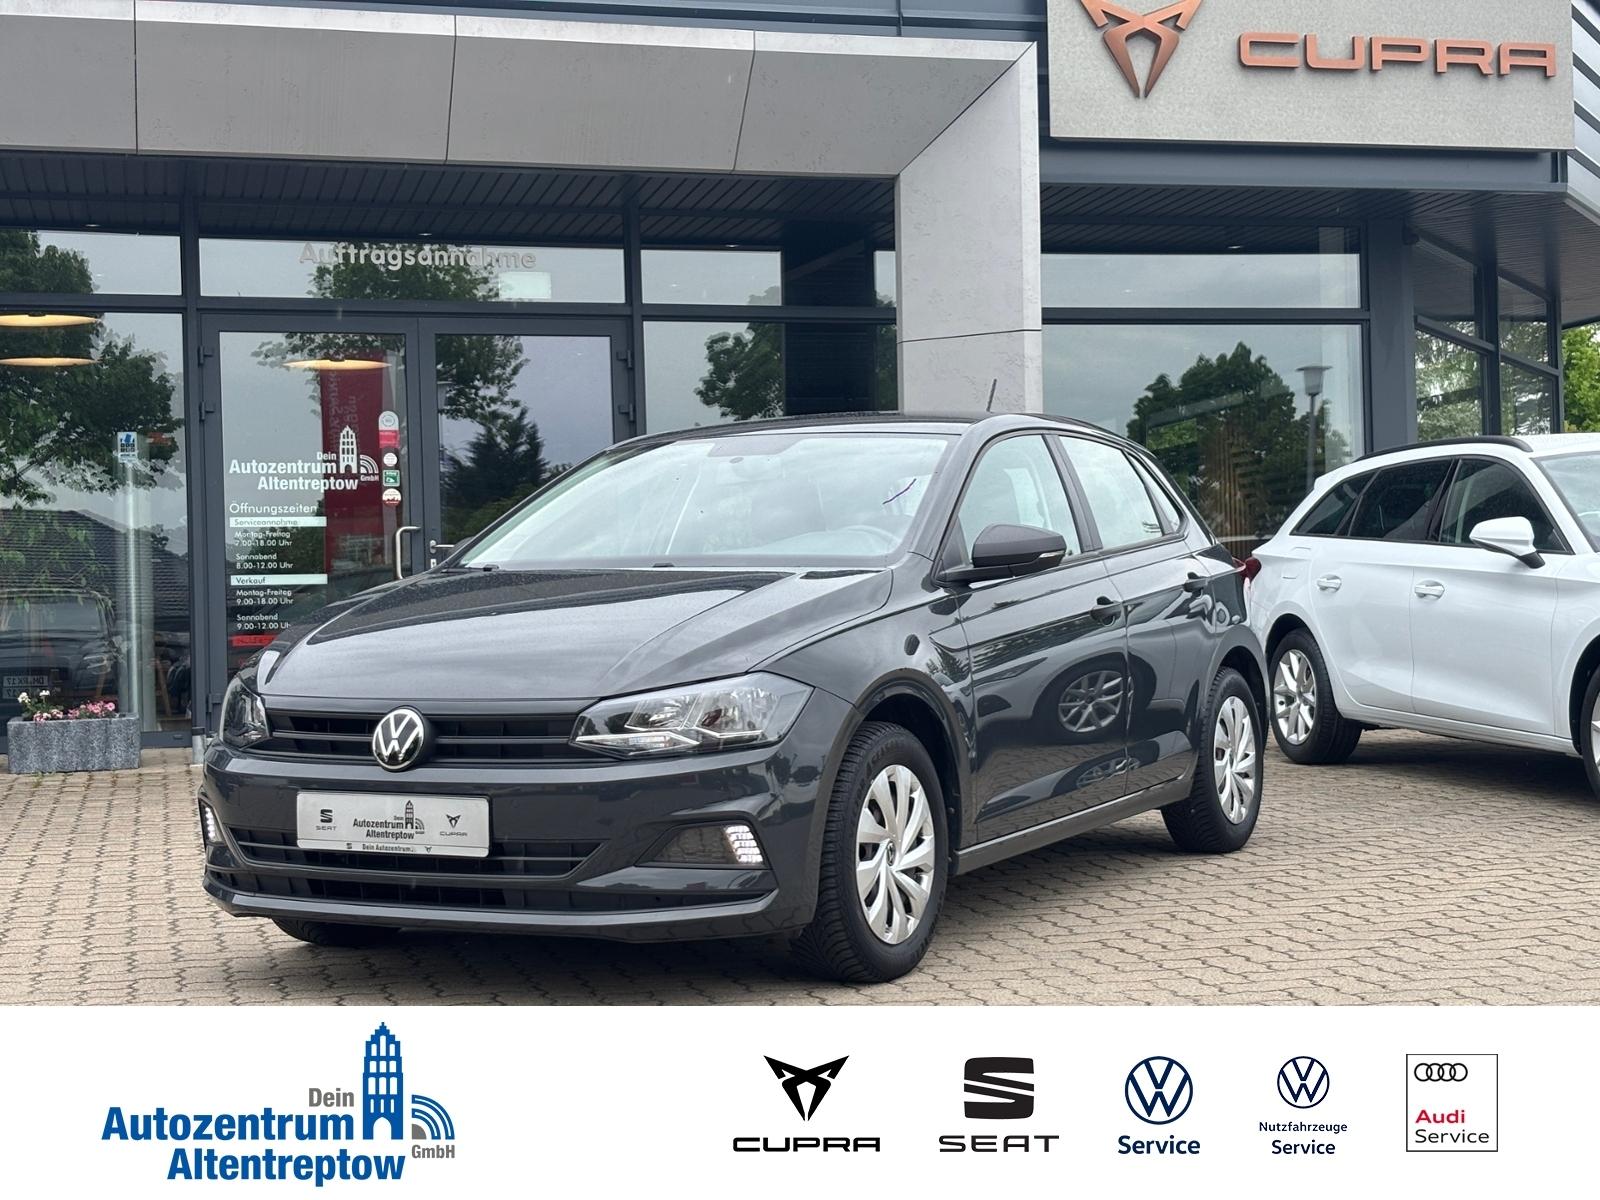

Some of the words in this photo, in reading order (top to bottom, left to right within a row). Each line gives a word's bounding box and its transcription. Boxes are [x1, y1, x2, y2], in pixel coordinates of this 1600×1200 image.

[1240, 31, 1556, 77] CUPRA
[299, 239, 536, 270] Auftragsannahme
[317, 452, 337, 460] Dein
[229, 459, 337, 474] Autozentrum
[257, 476, 359, 493] Altentreptow
[229, 500, 318, 516] Öffnungszeiten
[234, 530, 291, 539] Montag-Freitag
[278, 539, 293, 547] Uhr
[235, 553, 278, 561] Sonnabend
[236, 562, 278, 570] 8.00-12.00
[279, 561, 294, 569] Uhr
[236, 577, 266, 585] Verkauf
[236, 588, 292, 597] Montag-Freitag
[236, 598, 278, 606] 9.00-18.00
[280, 597, 294, 605] Uhr
[236, 613, 278, 621] Sonnabend
[237, 622, 279, 630] 9.00-12.00
[353, 818, 404, 829] Autozentrum
[366, 829, 415, 841] Altentreptow
[440, 830, 468, 838] CUPRA
